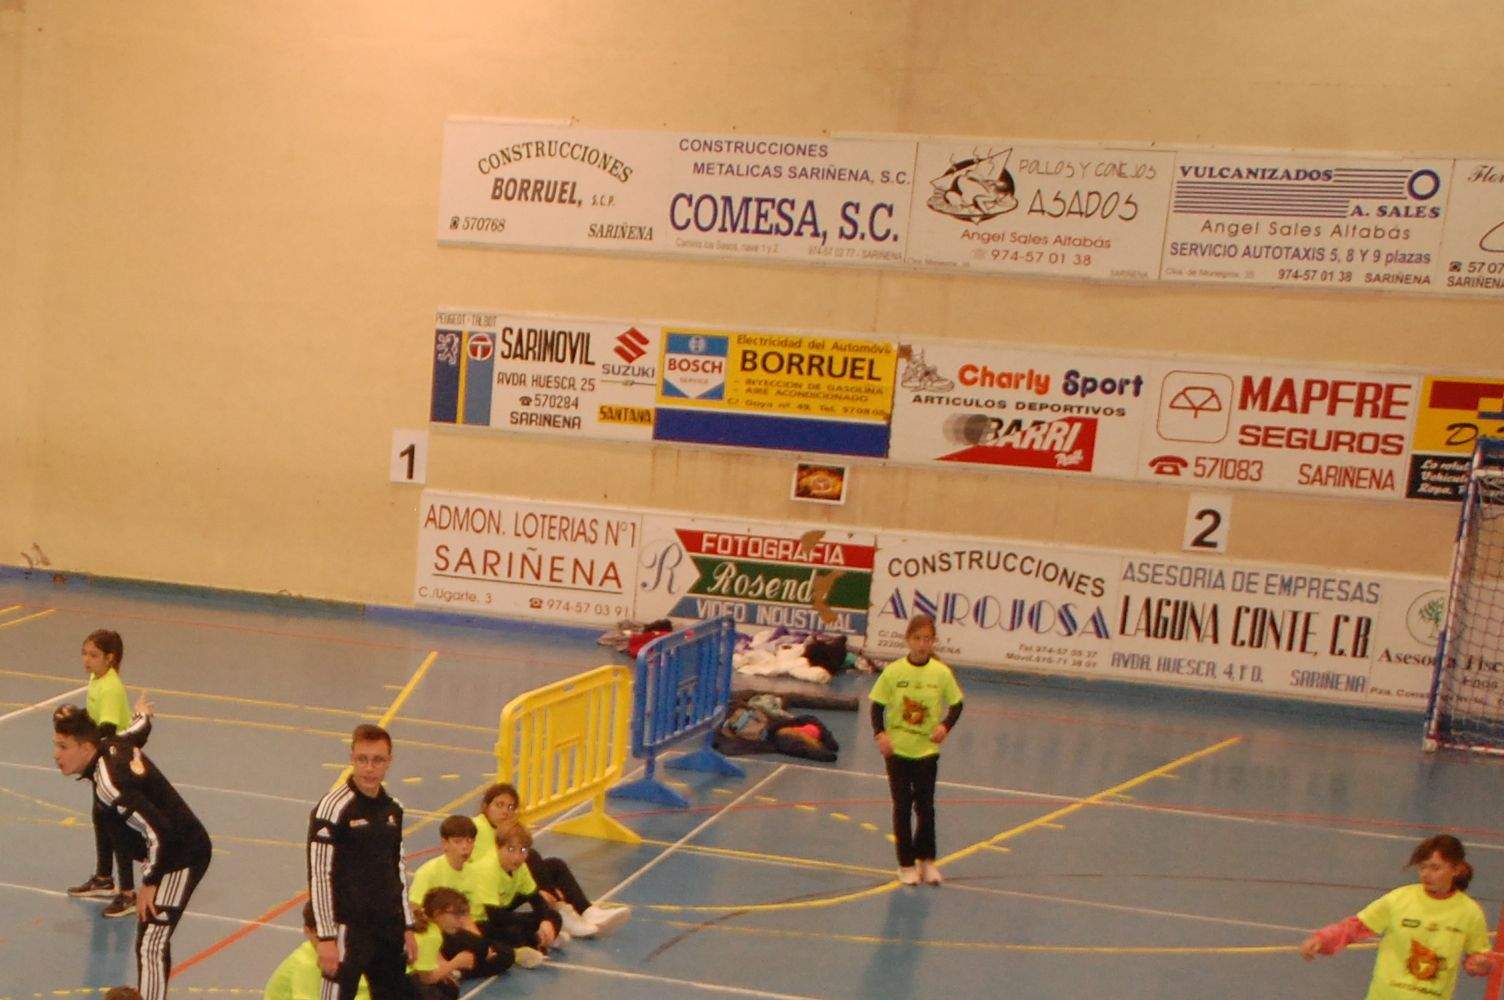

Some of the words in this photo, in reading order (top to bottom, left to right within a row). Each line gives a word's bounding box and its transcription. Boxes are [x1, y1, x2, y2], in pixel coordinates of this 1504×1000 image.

[478, 140, 634, 184] CONSTRUCCIONES
[679, 138, 829, 158] CONSTRUCCIONES
[693, 162, 783, 179] METALICAS
[788, 164, 874, 184] SARIÑENA,
[880, 170, 911, 185] S.C.
[1019, 159, 1075, 178] POLLOS
[1081, 161, 1093, 176] Y
[1095, 161, 1156, 180] CONEJOS
[1180, 165, 1334, 181] VULCANIZADOS
[491, 178, 582, 207] BORRUEL,
[1027, 188, 1138, 221] ASADOS
[670, 192, 828, 246] COMESA,
[838, 201, 898, 242] S.C.
[1351, 205, 1369, 218] A.
[1376, 205, 1441, 219] SALES
[588, 222, 654, 240] SARIÑENA
[960, 229, 1006, 244] Angel
[1009, 231, 1048, 245] Sales
[1200, 220, 1259, 238] Angel
[1269, 220, 1322, 237] Sales
[991, 249, 1043, 264] 974-57
[1049, 252, 1065, 265] 01
[1073, 254, 1091, 266] 38
[1170, 242, 1237, 258] SERVICIO
[1241, 244, 1325, 261] AUTOTAXIS
[1346, 249, 1354, 263] 8
[1359, 249, 1369, 262] Y
[1373, 249, 1381, 263] 9
[1385, 249, 1431, 266] plazas
[1278, 269, 1317, 282] 974-57
[1320, 271, 1335, 282] 01
[1338, 271, 1353, 283] 38
[1364, 272, 1431, 285] SARIÑENA
[501, 327, 595, 366] SARIMOVIL
[737, 334, 801, 349] Electricidad
[808, 336, 825, 349] del
[602, 364, 656, 378] SUZUKI
[668, 358, 723, 374] BOSCH
[740, 350, 882, 382] BORRUEL
[958, 364, 1051, 396] Charly
[1061, 369, 1143, 398] Sport
[581, 377, 596, 392] 25
[1238, 375, 1412, 420] MAPFRE
[534, 394, 578, 410] 570284
[599, 405, 652, 424] SANTANA
[912, 394, 1007, 410] ARTICULOS
[1015, 401, 1127, 417] DEPORTIVOS
[1238, 424, 1405, 455] SEGUROS
[399, 443, 416, 480] 1
[1193, 457, 1264, 481] 571083
[1297, 463, 1395, 491] SARIÑENA
[424, 504, 506, 535] ADMON.
[514, 511, 599, 545] LOTERIAS
[1190, 508, 1222, 549] 2
[701, 533, 845, 566] FOTOGRAFIA
[434, 544, 622, 589] SARIÑENA
[888, 550, 1105, 598] CONSTRUCCIONES
[707, 561, 827, 603] Rosend
[1122, 562, 1226, 591] ASESORIA
[1231, 570, 1259, 594] DE
[1264, 573, 1381, 605] EMPRESAS
[877, 586, 1110, 640] ANROJOSA
[1119, 595, 1219, 645] LAGUNA
